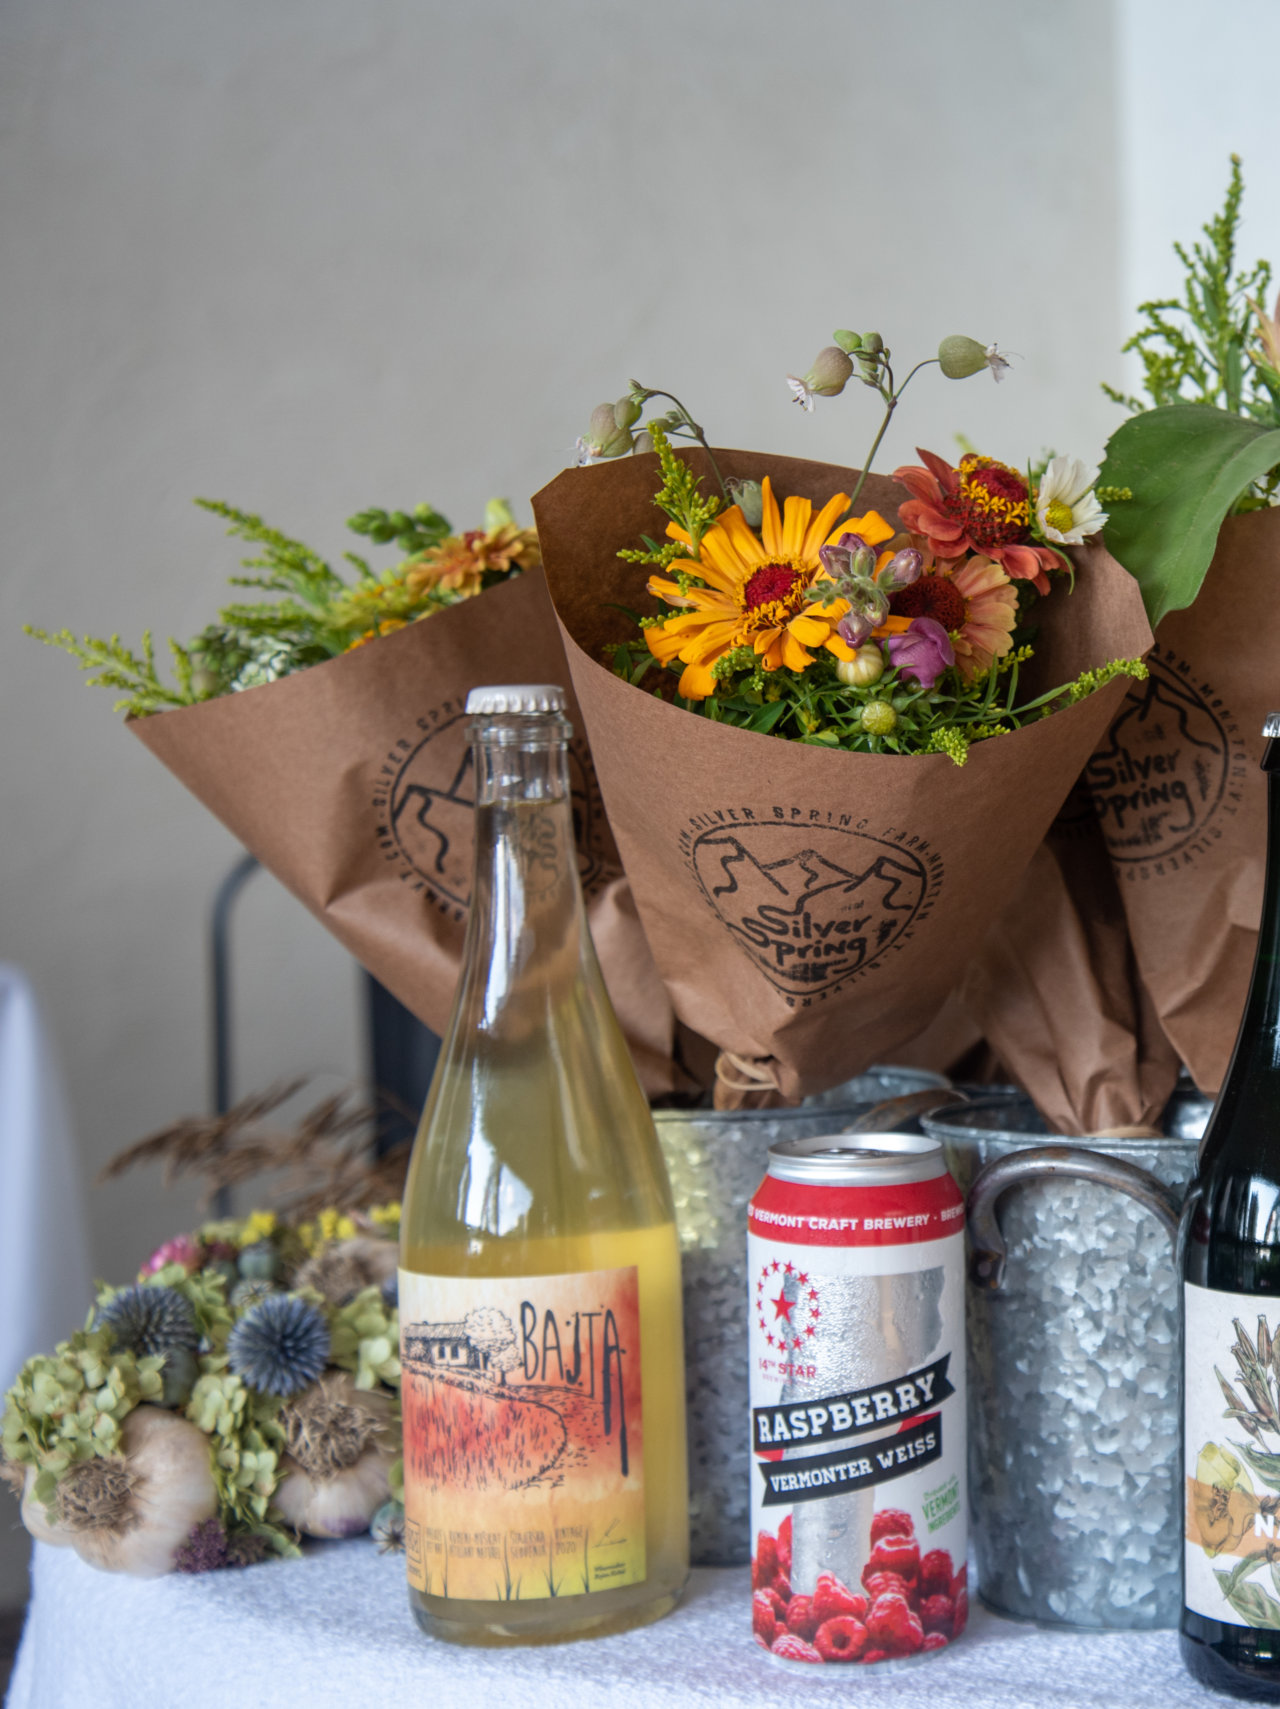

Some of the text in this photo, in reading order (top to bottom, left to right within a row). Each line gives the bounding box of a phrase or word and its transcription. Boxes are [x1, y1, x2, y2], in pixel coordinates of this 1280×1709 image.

[1086, 747, 1182, 791] Silver
[689, 806, 756, 831] SILVER
[772, 806, 869, 830] SPRING
[882, 827, 931, 854] FARM
[741, 916, 868, 975] Spring
[757, 905, 873, 940] Silver
[755, 1207, 805, 1229] VERMONT
[808, 1215, 859, 1231] CRAFT
[863, 1213, 930, 1231] BREWERY
[520, 1301, 628, 1477] BAJTA
[778, 1362, 818, 1379] STAR
[757, 1372, 937, 1444] RASPBERRY
[769, 1433, 937, 1493] VERMONTER WEISS
